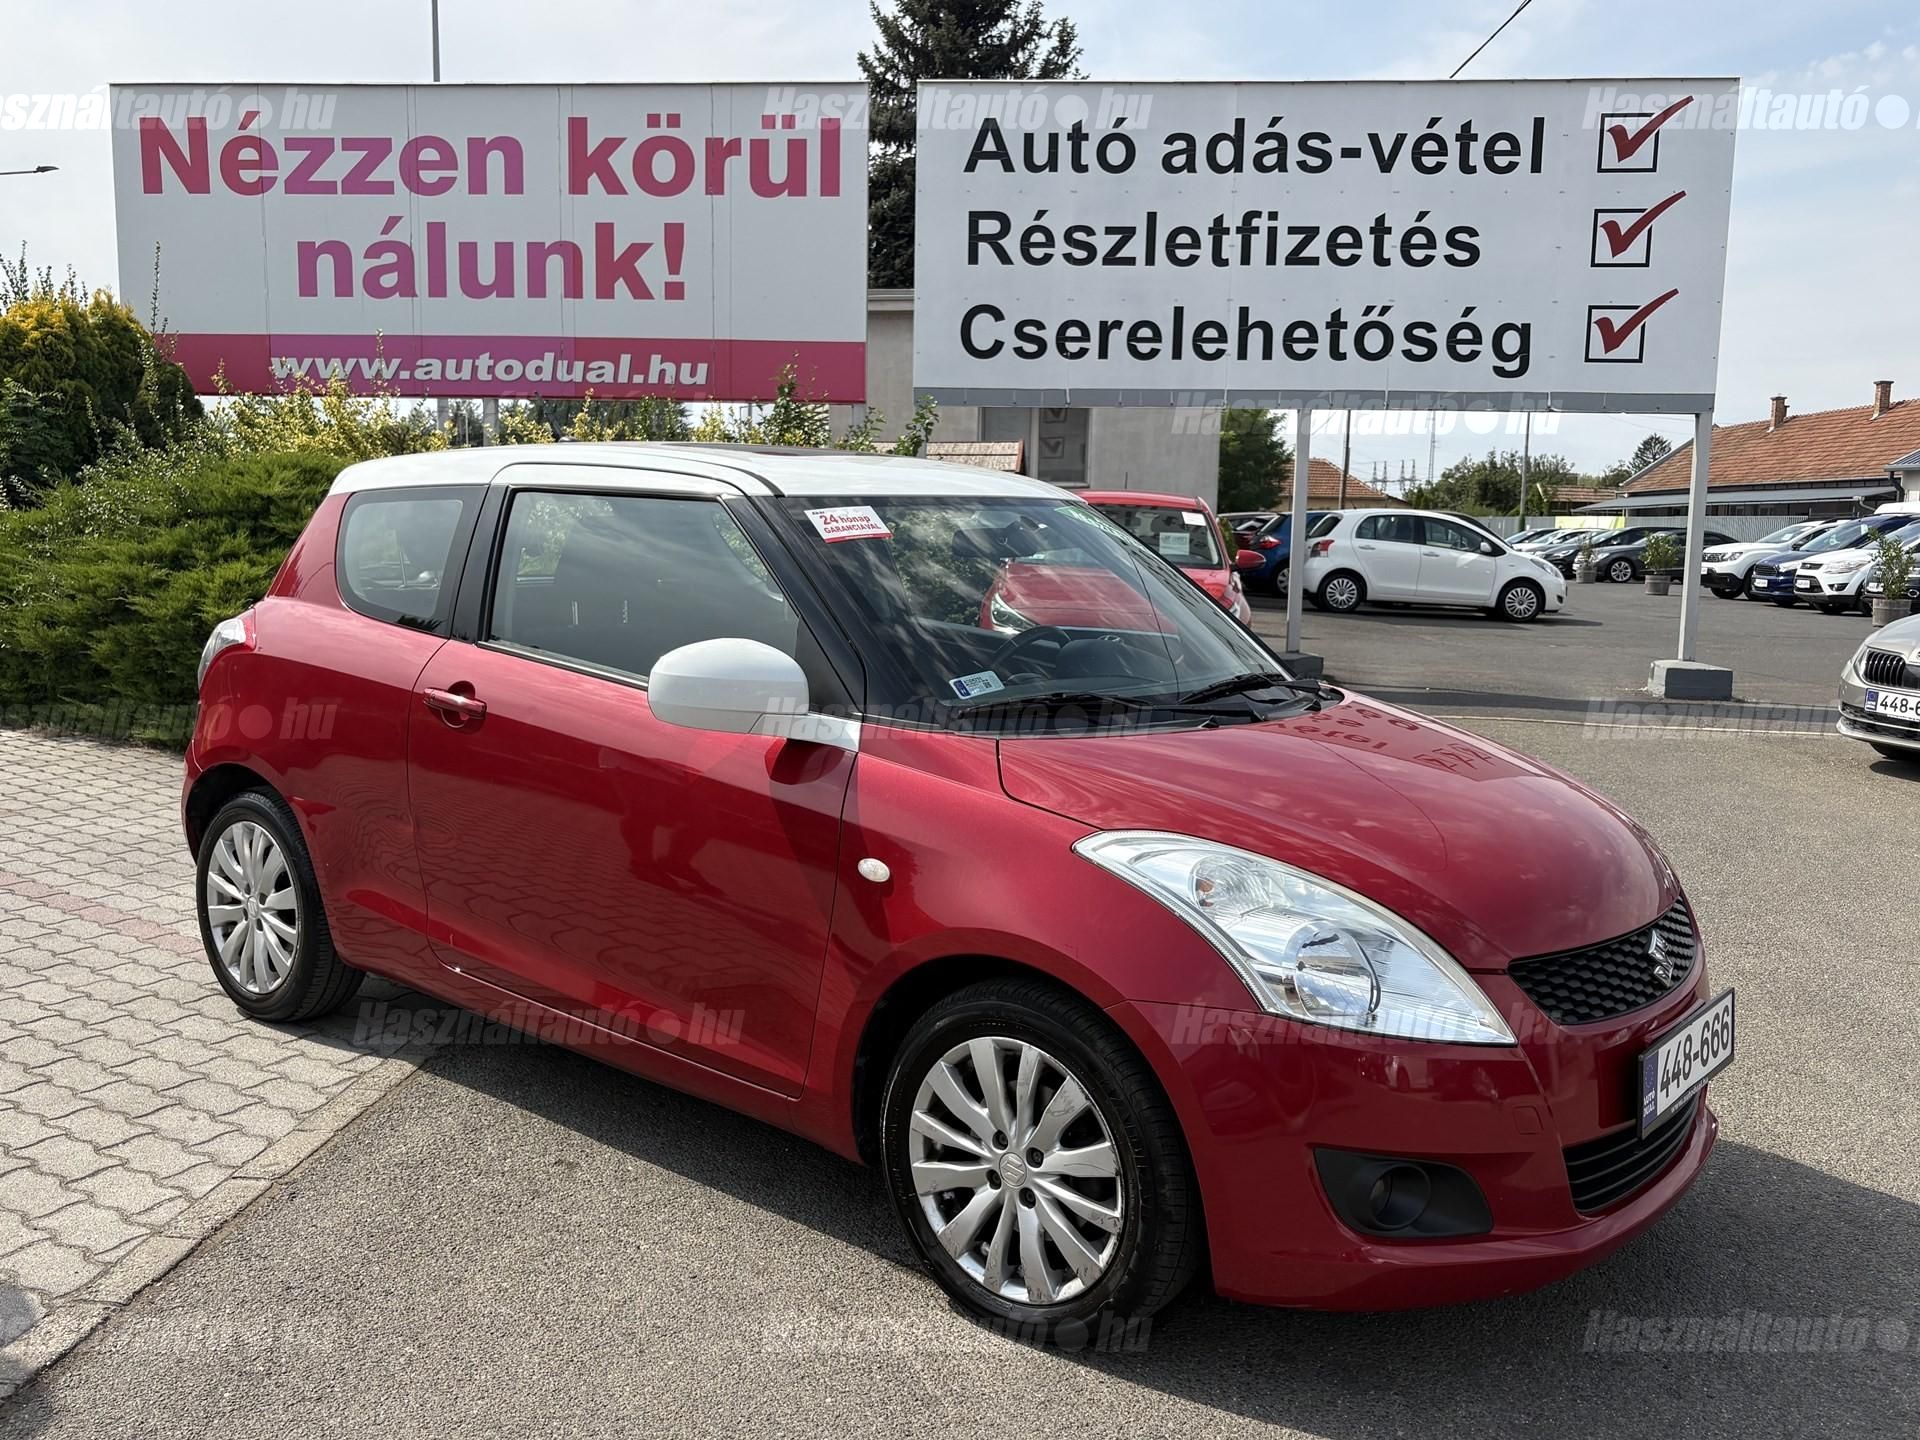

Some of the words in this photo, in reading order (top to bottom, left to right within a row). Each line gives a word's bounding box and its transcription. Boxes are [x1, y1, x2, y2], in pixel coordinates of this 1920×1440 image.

[138, 111, 525, 197] Nézzen
[567, 112, 842, 198] körül
[963, 116, 1137, 174] Autó
[1161, 115, 1545, 176] adás-vétel
[297, 216, 686, 301] nálunk!
[966, 207, 1482, 268] Részletfizetés
[271, 351, 709, 385] www.autodual.hu
[959, 301, 1532, 378] Cserelehetőség
[819, 513, 839, 526] 24
[1660, 1004, 1730, 1099] 448-666
